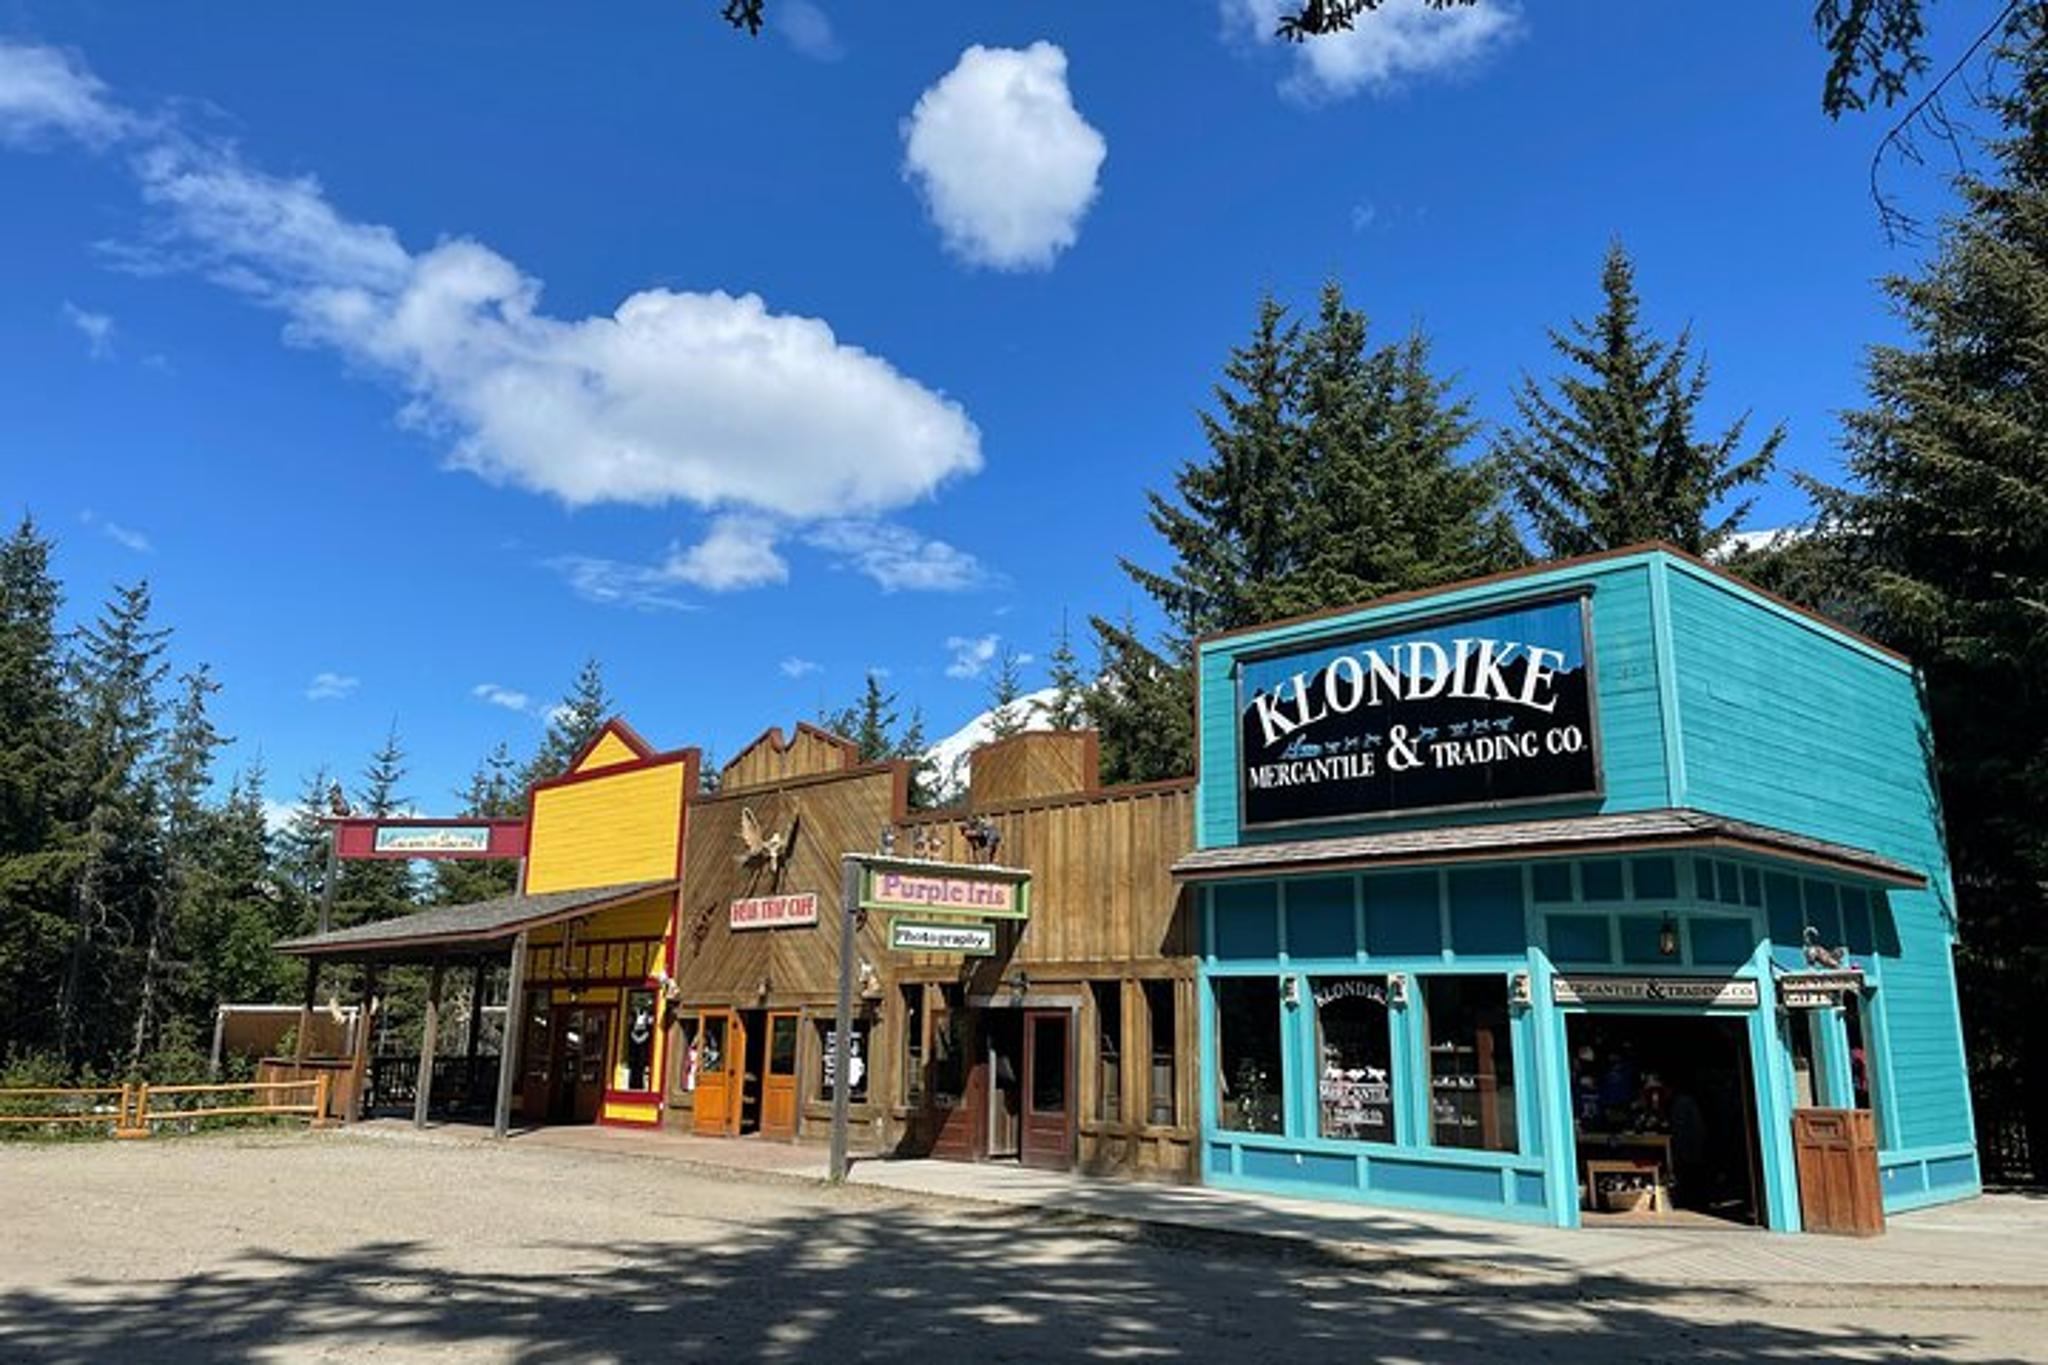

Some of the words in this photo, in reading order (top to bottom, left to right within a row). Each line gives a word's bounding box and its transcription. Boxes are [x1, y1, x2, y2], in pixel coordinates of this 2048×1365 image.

[1252, 637, 1567, 748] KLONDIKE
[1248, 752, 1375, 789] MERCANTILE
[1386, 724, 1425, 771] &
[1430, 730, 1539, 769] TRADING
[882, 871, 963, 904] Purple
[967, 879, 1005, 905] Iris
[895, 928, 985, 947] Photography
[1646, 979, 1665, 999] &
